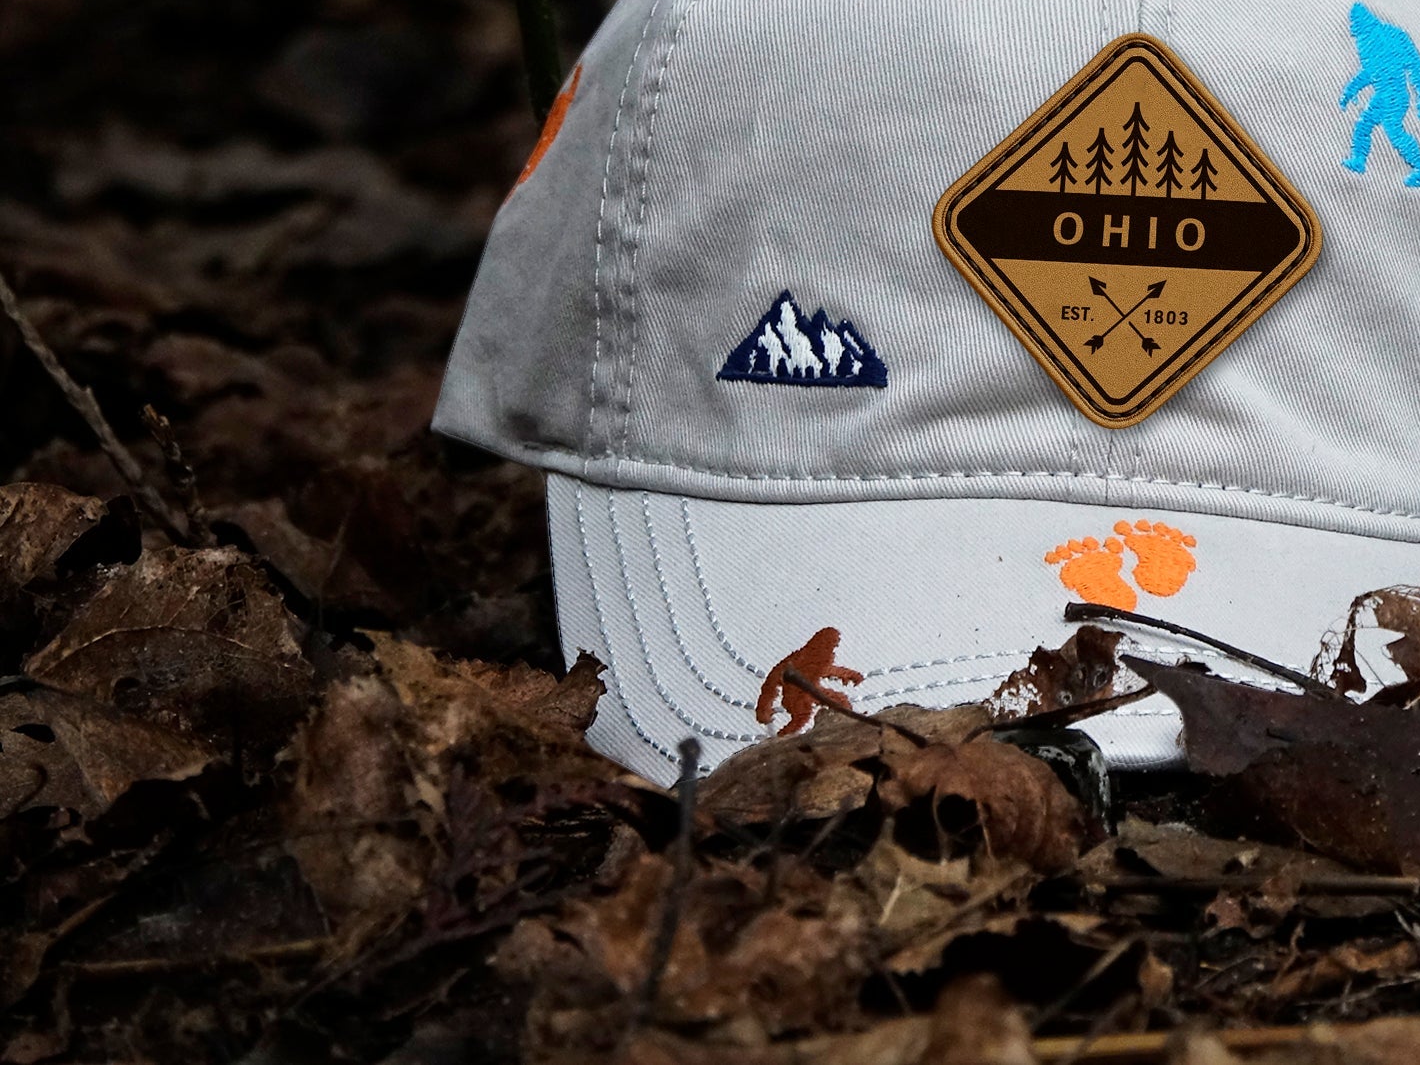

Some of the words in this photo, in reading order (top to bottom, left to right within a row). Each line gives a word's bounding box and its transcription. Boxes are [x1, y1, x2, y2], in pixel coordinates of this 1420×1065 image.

[1053, 211, 1206, 252] OHIO
[1061, 305, 1095, 322] EST.
[1143, 309, 1189, 326] 1803
